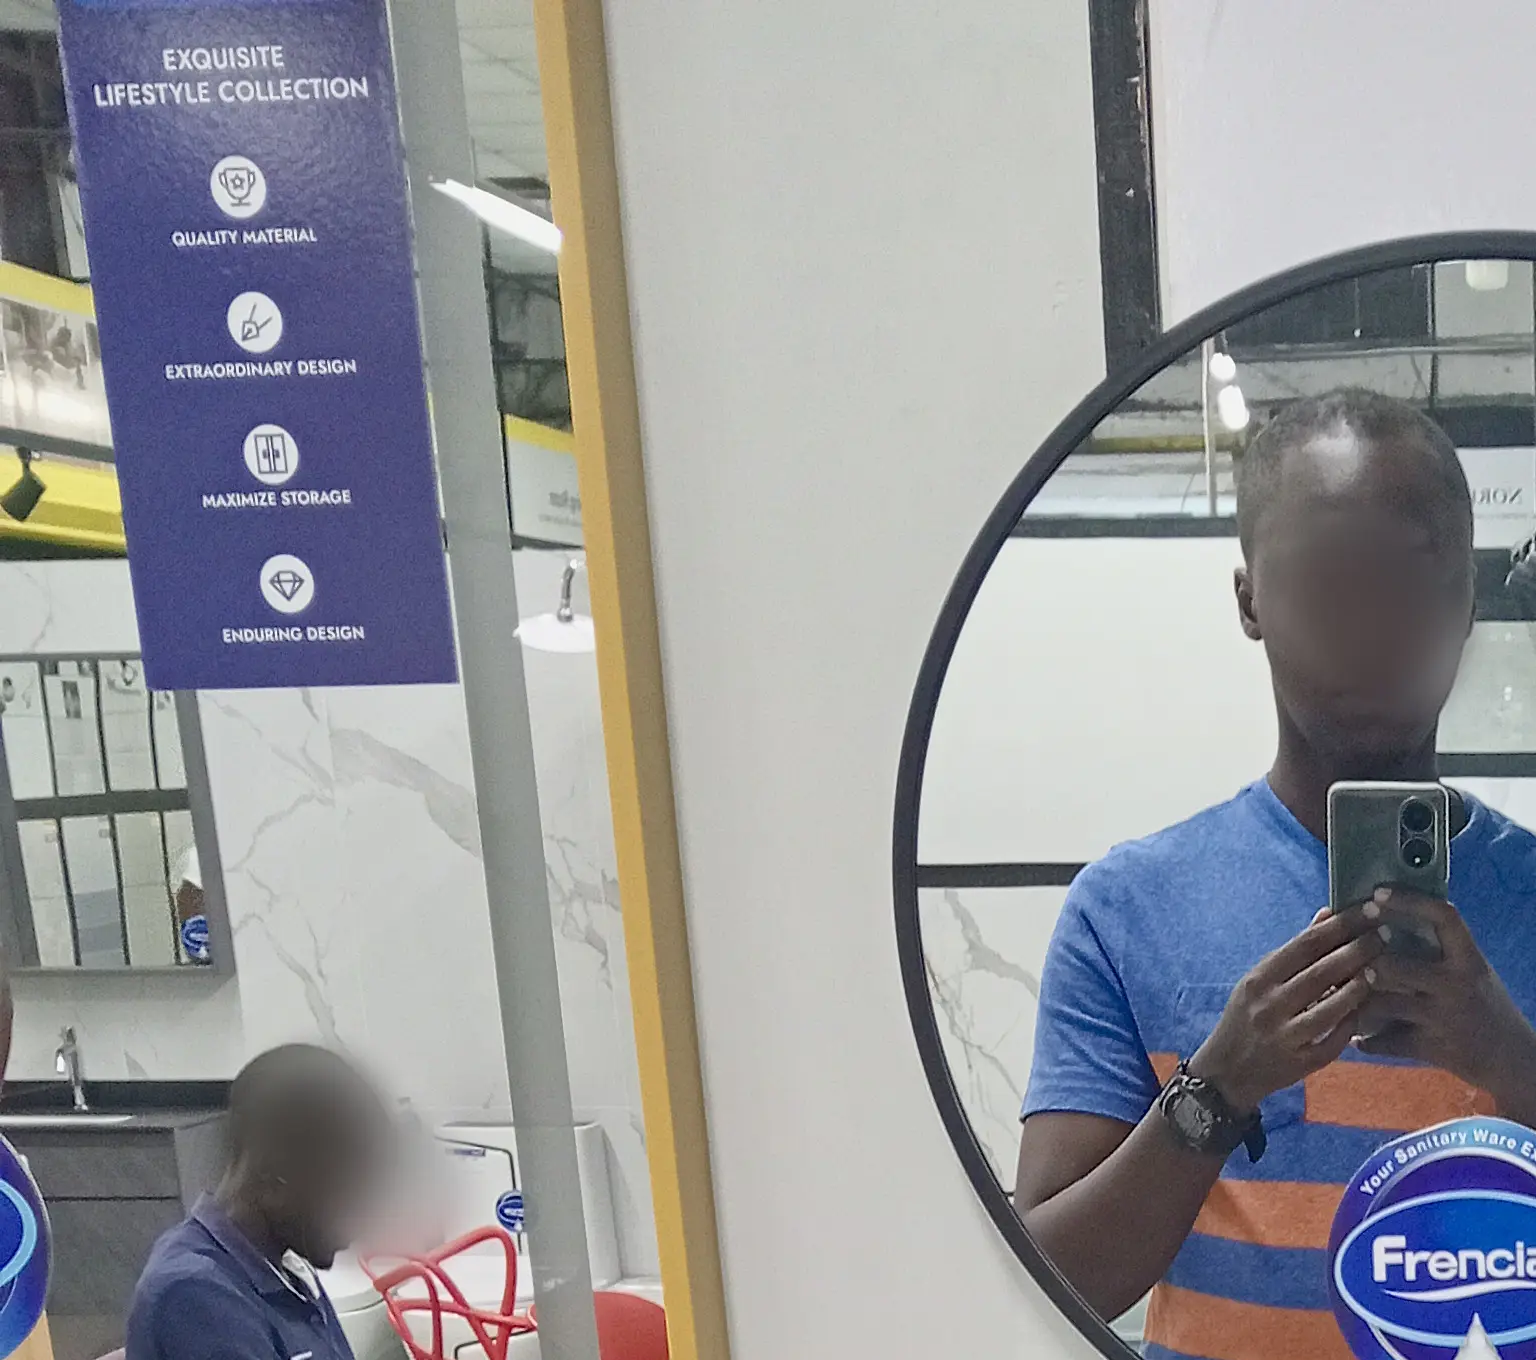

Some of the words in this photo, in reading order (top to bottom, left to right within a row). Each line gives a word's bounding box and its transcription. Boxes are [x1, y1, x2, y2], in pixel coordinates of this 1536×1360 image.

[162, 45, 286, 71] EXQUISITE
[93, 81, 212, 108] LIFESTYLE
[217, 76, 370, 103] COLLECTION
[171, 229, 238, 247] QUALITY
[242, 227, 318, 245] MATERIAL
[164, 361, 293, 380] EXTRAORDINARY
[297, 359, 357, 376] DESIGN
[202, 491, 277, 508] MAXIMIZE
[280, 489, 352, 506] STORAGE
[222, 627, 303, 643] ENDURING
[306, 625, 365, 642] DESIGN
[1359, 1160, 1395, 1197] Your
[1396, 1129, 1467, 1164] Sanitary
[1472, 1127, 1516, 1150] Ware
